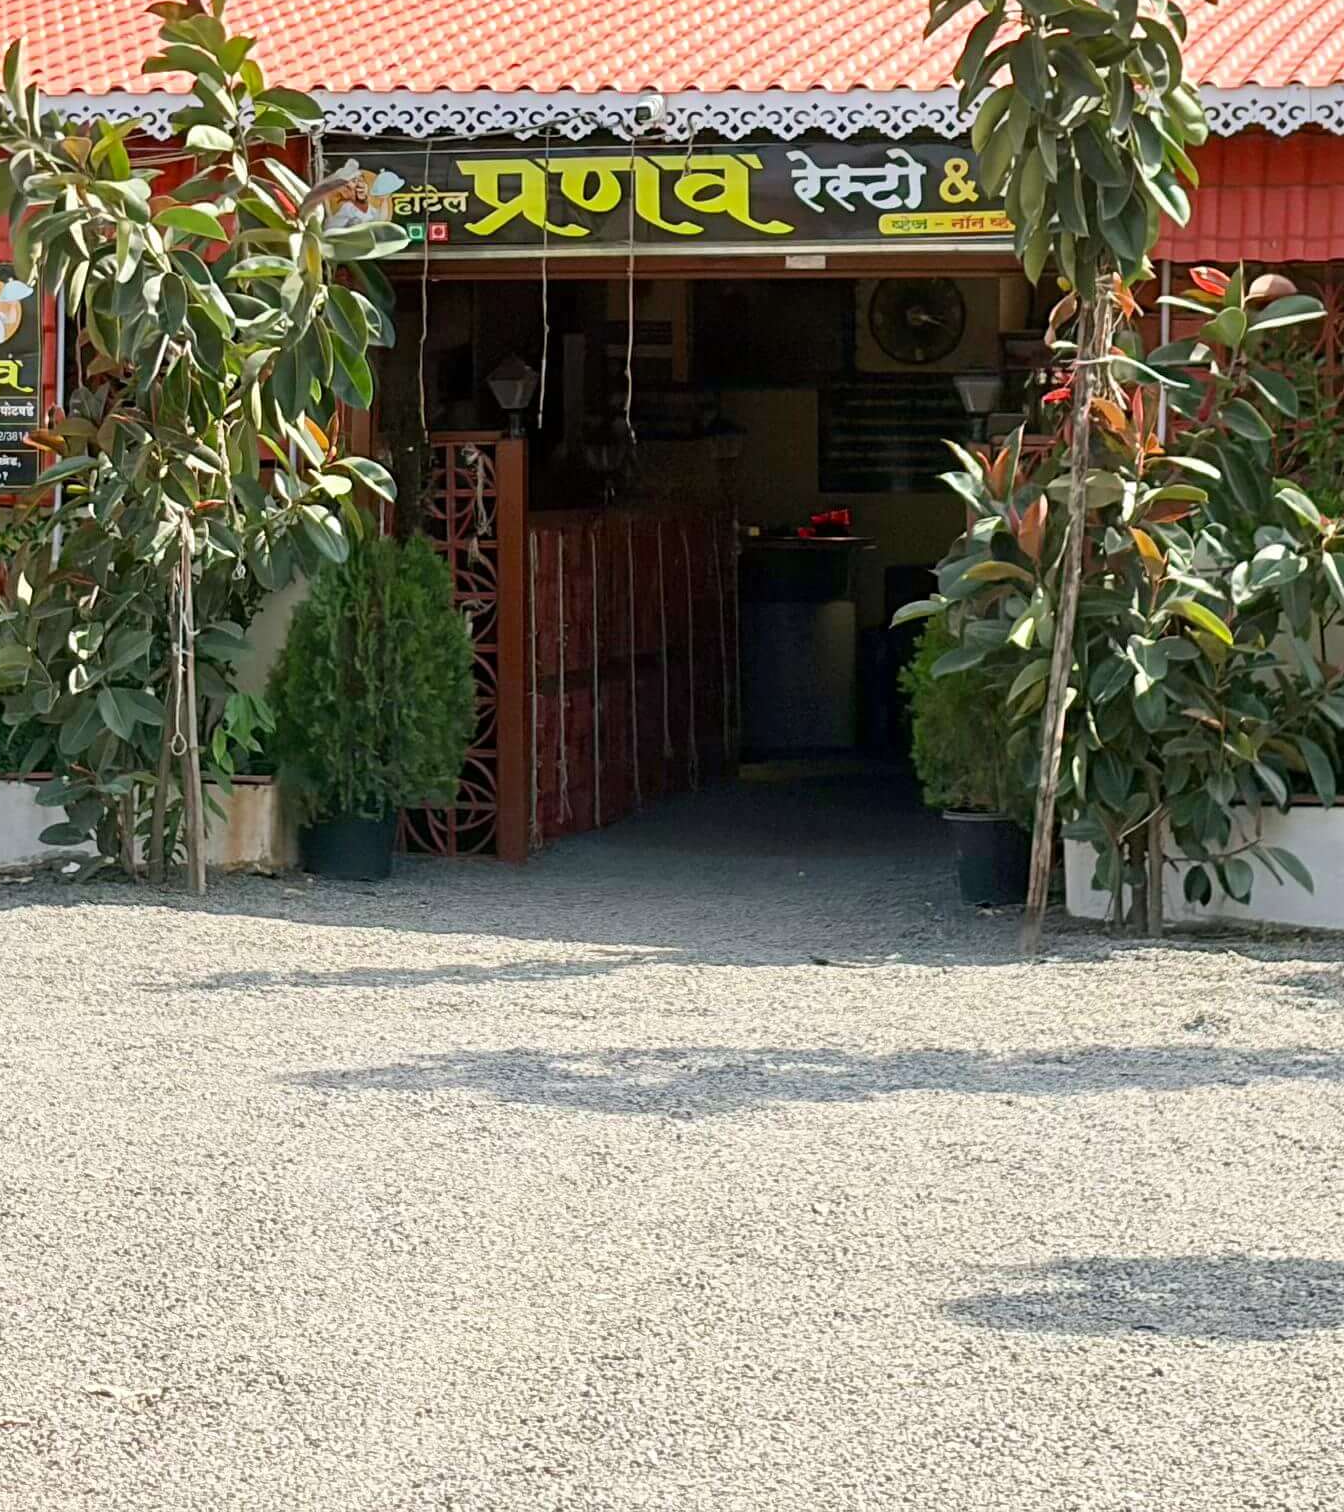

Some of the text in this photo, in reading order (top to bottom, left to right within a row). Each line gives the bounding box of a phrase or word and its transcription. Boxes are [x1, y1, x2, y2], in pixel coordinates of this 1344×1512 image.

[392, 147, 979, 237] हॉटेल प्रणव रेस्टो &
